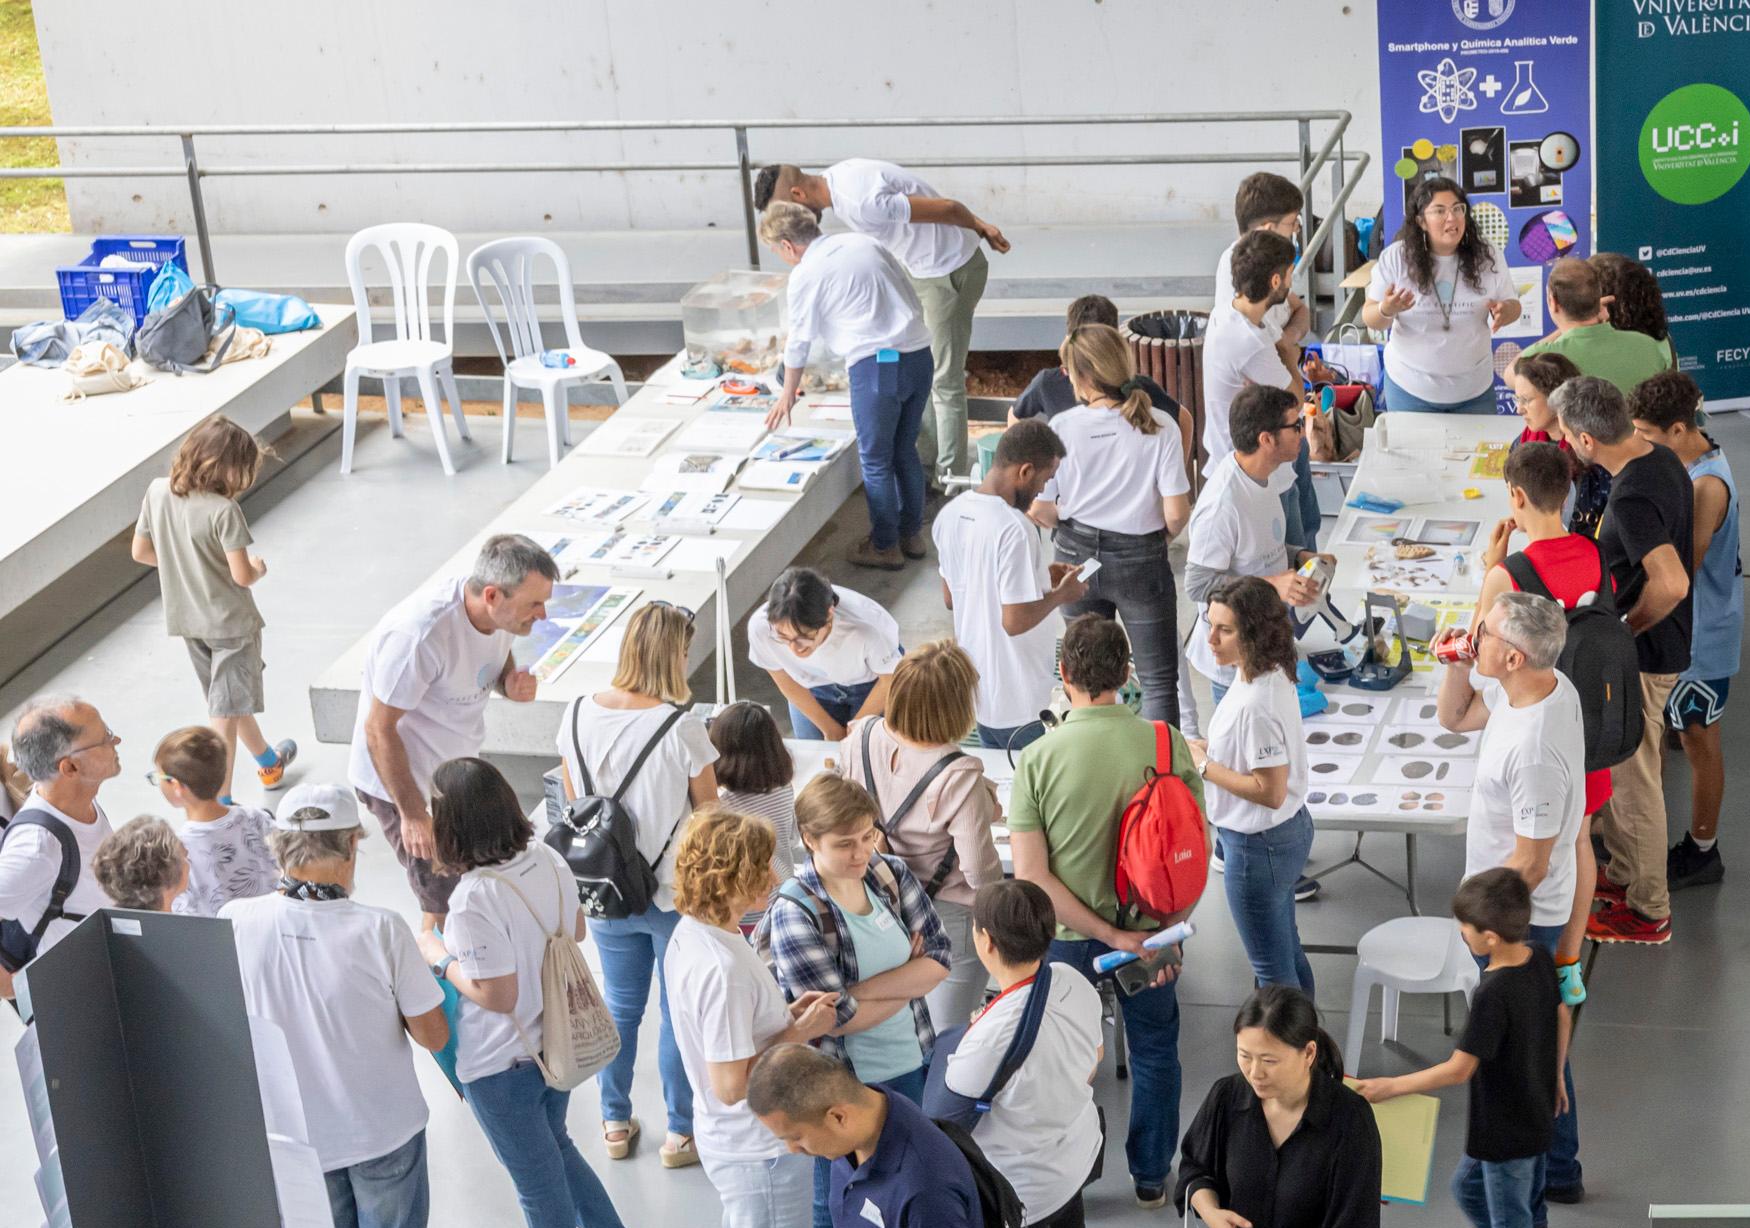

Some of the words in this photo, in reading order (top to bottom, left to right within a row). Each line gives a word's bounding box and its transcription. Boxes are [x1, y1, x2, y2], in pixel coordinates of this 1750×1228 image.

[1388, 41, 1450, 53] Smartphone
[1452, 43, 1459, 52] y
[1549, 35, 1579, 45] Verde
[1661, 285, 1728, 299] ww.uv.es/cdciencia
[1174, 848, 1193, 865] Laia
